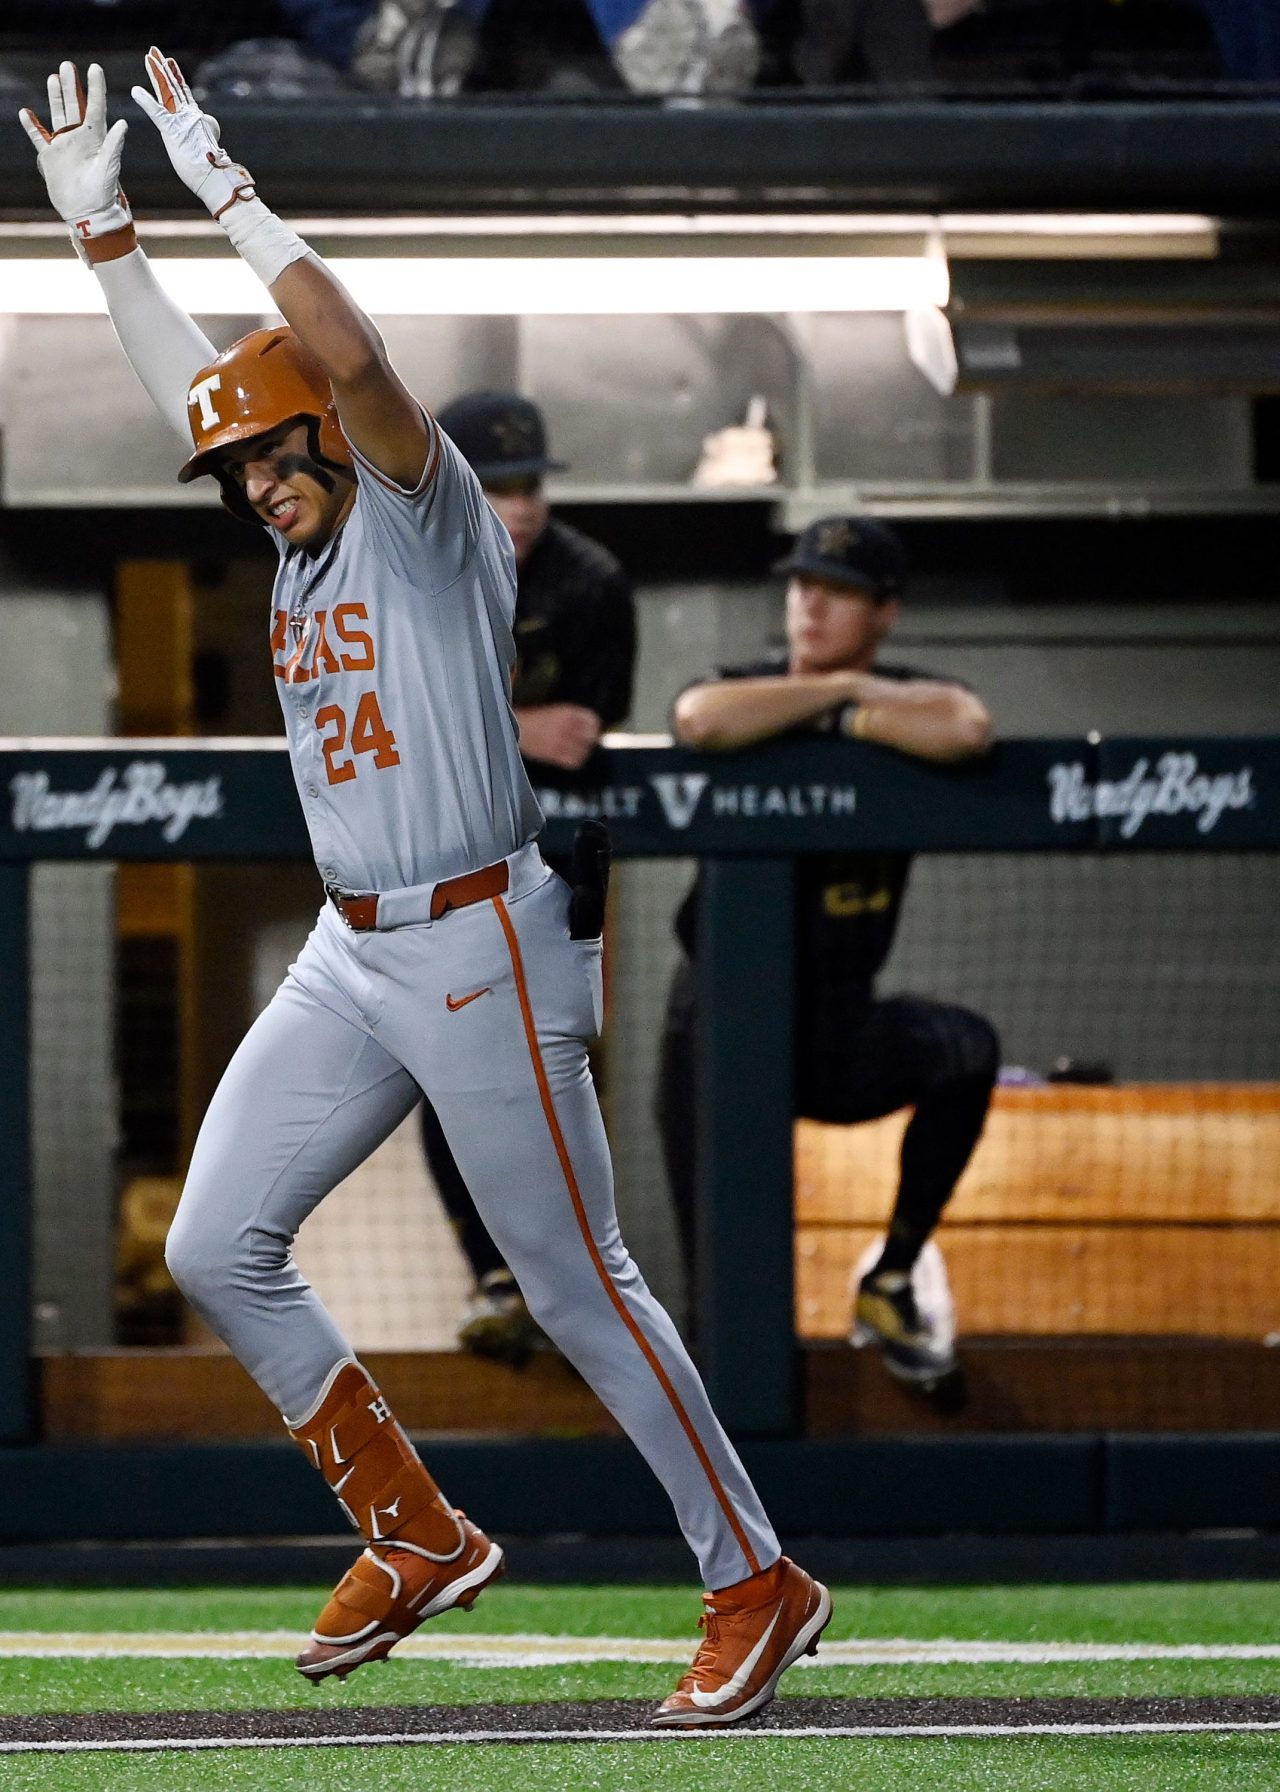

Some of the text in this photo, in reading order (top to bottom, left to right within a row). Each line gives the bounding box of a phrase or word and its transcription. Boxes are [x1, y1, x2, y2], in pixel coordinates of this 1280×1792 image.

[76, 219, 92, 238] T
[189, 373, 221, 431] T
[315, 691, 401, 785] 24
[712, 785, 857, 817] HEALTH
[367, 1397, 391, 1424] H
